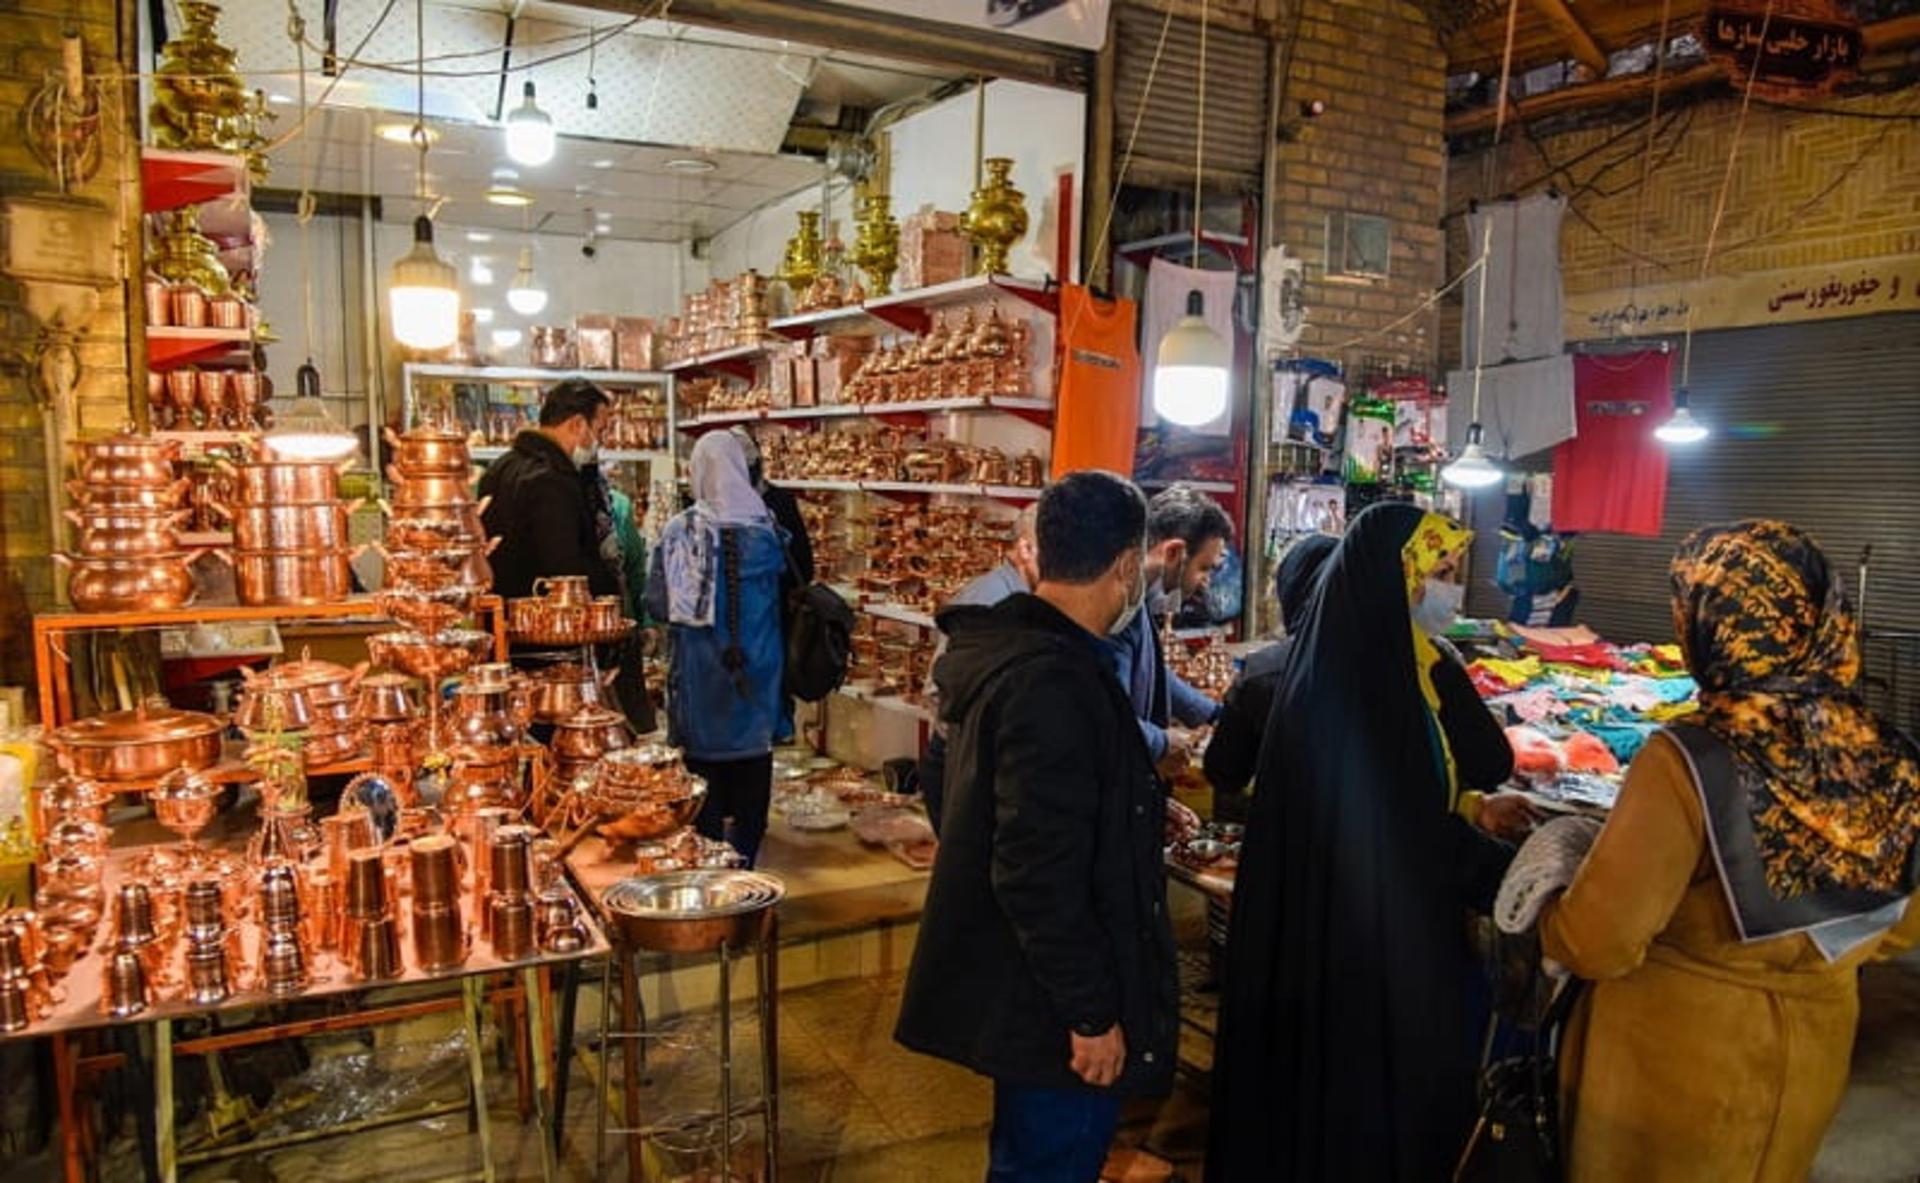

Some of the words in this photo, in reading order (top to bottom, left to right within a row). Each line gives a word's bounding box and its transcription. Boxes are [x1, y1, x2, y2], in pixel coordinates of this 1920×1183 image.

[1766, 28, 1809, 55] حلبی
[1811, 33, 1849, 63] بازار
[1888, 275, 1900, 301] و
